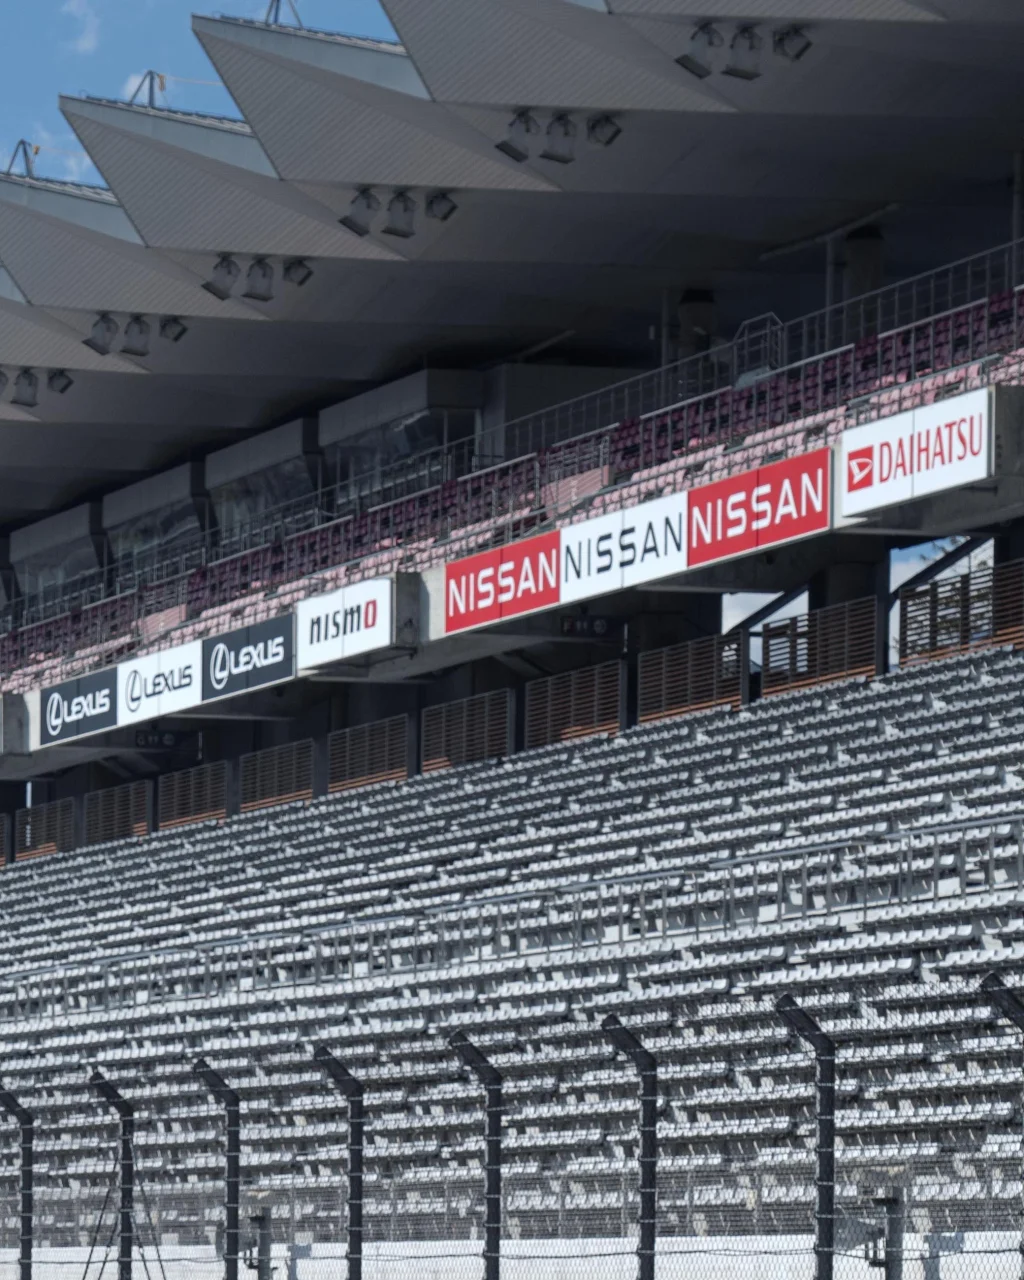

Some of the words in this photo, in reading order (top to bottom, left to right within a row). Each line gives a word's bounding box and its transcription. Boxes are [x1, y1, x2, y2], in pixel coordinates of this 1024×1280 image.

[878, 412, 984, 483] DAIHATSU
[691, 467, 824, 548] NISSAN
[564, 511, 683, 583] NISSAN
[448, 549, 557, 618] NISSAN
[143, 665, 193, 699] LEXUS
[229, 636, 285, 676] LEXUS
[62, 688, 111, 723] LEXUS
